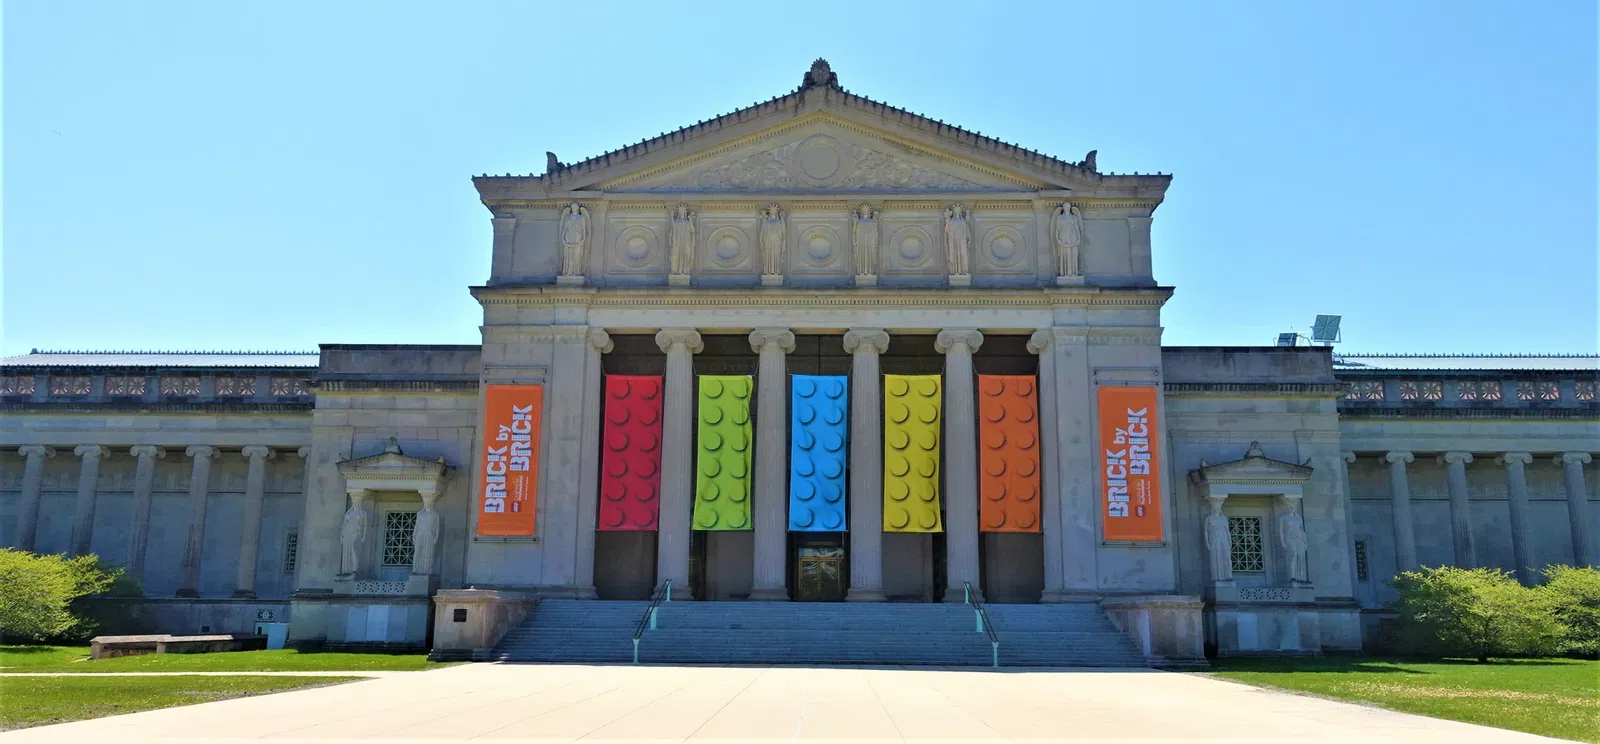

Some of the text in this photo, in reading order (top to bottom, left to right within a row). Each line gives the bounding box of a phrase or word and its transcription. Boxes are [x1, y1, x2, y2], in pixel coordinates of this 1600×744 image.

[484, 425, 511, 513] BRICK by
[510, 405, 532, 471] BRICK
[1107, 428, 1130, 517] BRICK by
[1128, 408, 1150, 474] BRICK
